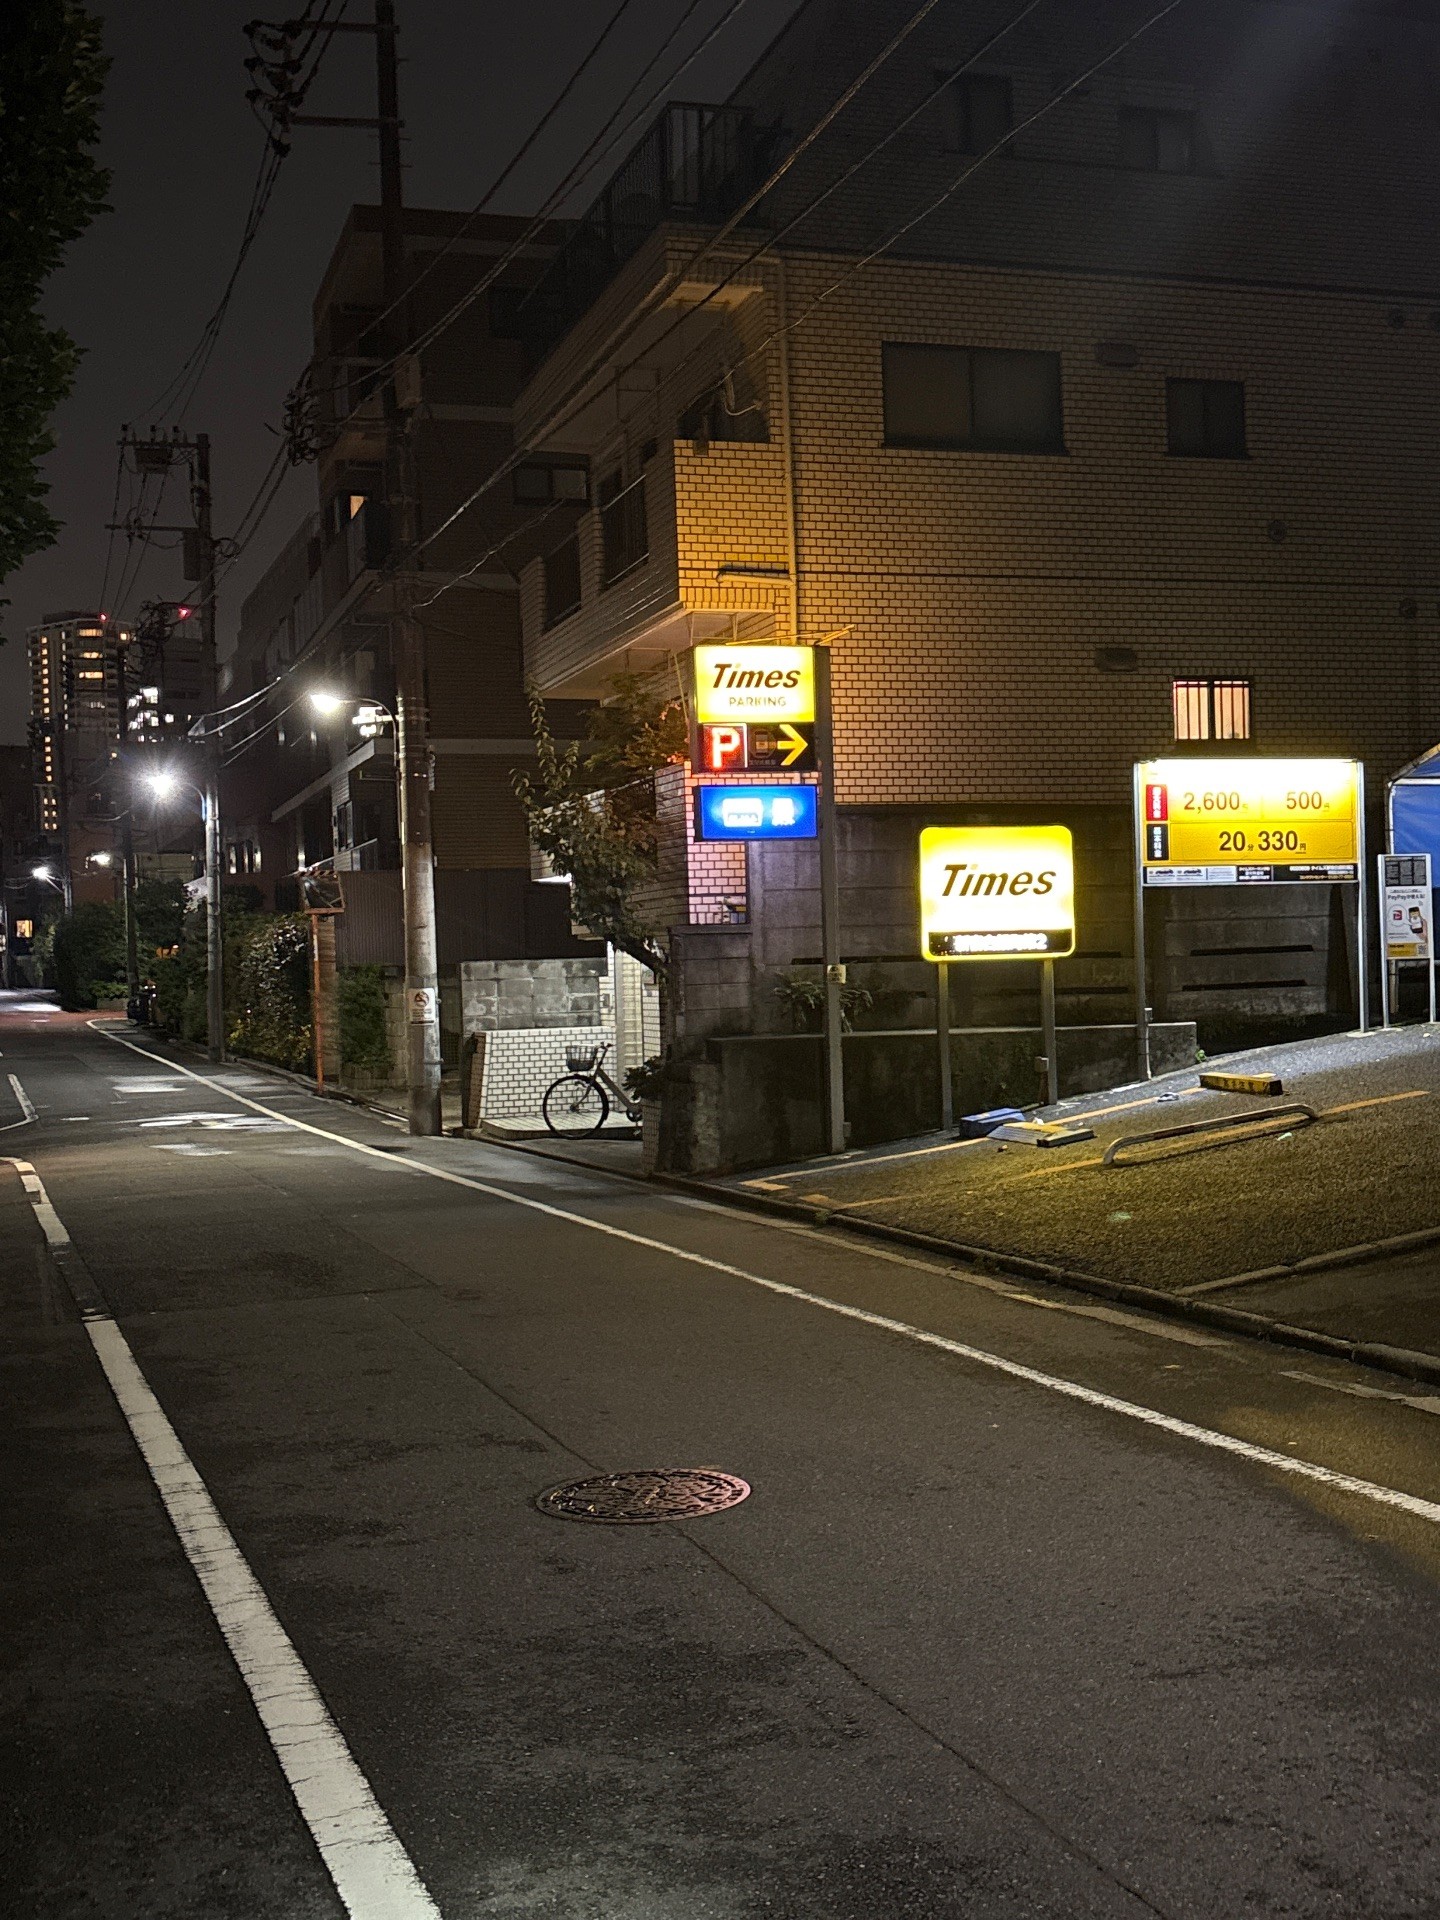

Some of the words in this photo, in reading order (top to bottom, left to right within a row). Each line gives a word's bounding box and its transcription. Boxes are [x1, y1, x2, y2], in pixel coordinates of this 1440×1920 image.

[713, 663, 801, 688] Times
[729, 696, 786, 707] PARKING
[712, 727, 740, 768] P
[942, 864, 1057, 896] Times
